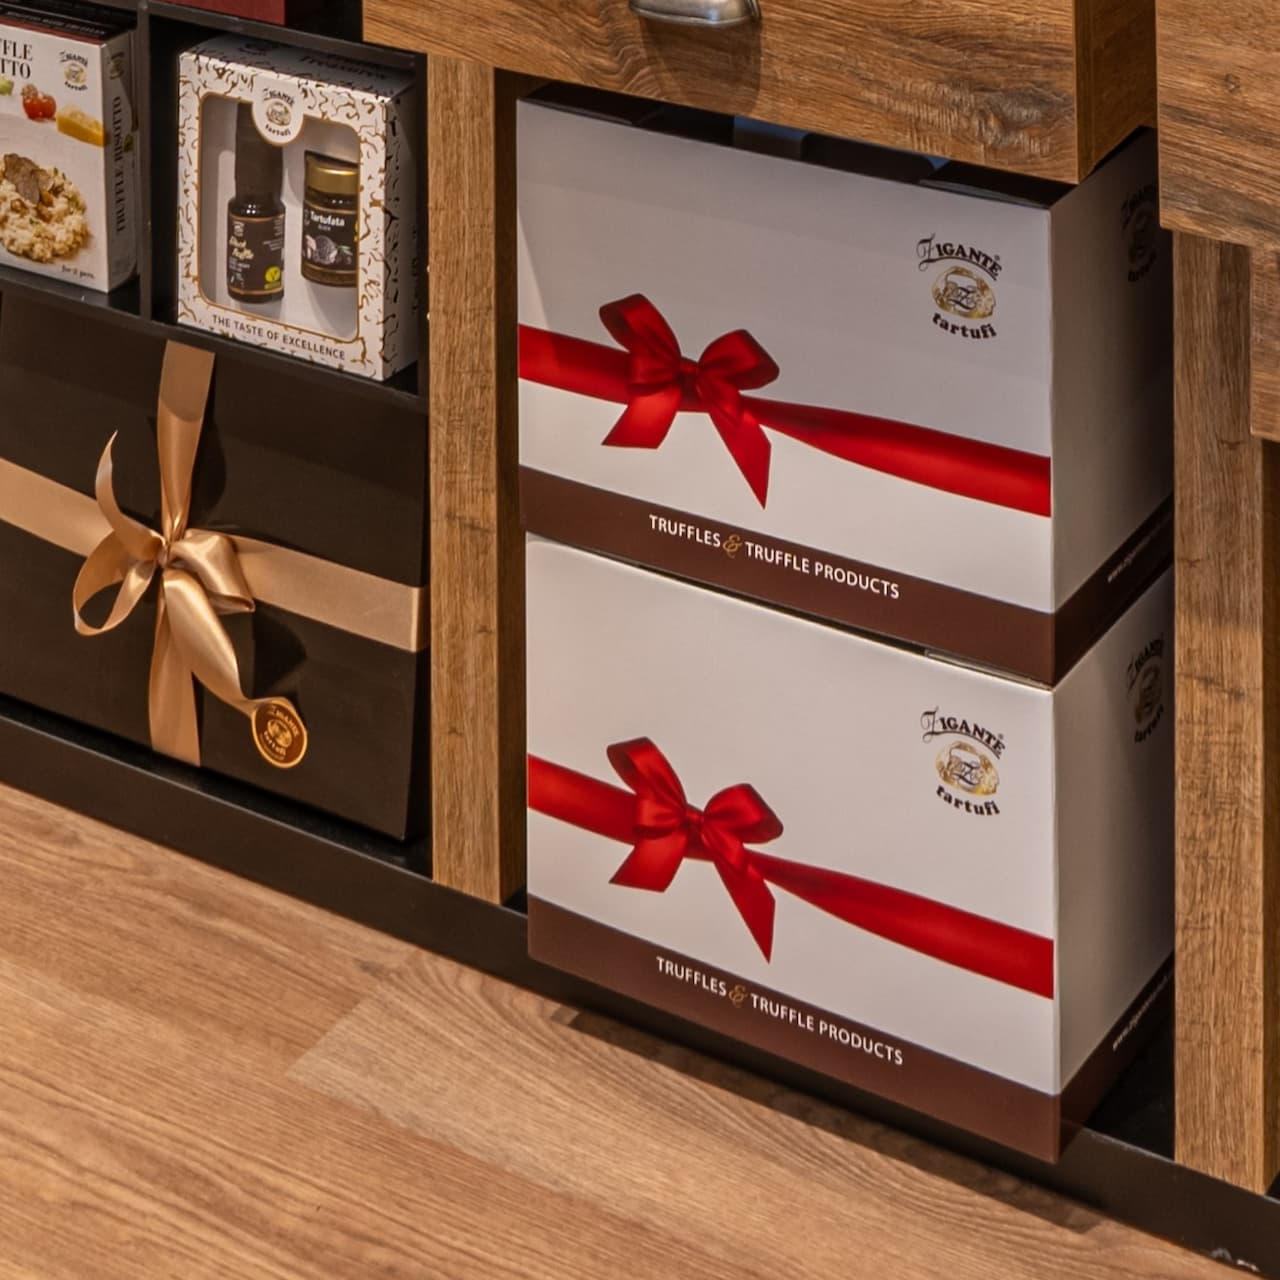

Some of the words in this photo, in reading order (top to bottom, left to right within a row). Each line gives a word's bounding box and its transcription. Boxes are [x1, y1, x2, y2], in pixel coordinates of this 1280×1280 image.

[265, 124, 291, 136] tartufi
[310, 211, 345, 227] Tartufata
[213, 314, 230, 328] THE
[233, 320, 263, 337] TASTE
[266, 327, 279, 340] OF
[282, 331, 345, 361] EXCELLENCE
[932, 312, 997, 339] tartufi
[649, 514, 721, 547] TRUFFLES
[723, 534, 743, 558] &
[745, 541, 810, 573] TRUFFLE
[815, 562, 900, 599] PRODUCTS
[936, 785, 1000, 816] tartufi
[656, 956, 727, 997] TRUFFLES
[729, 984, 748, 1008] &
[750, 993, 814, 1032] TRUFFLE
[819, 1019, 904, 1065] PRODUCTS
